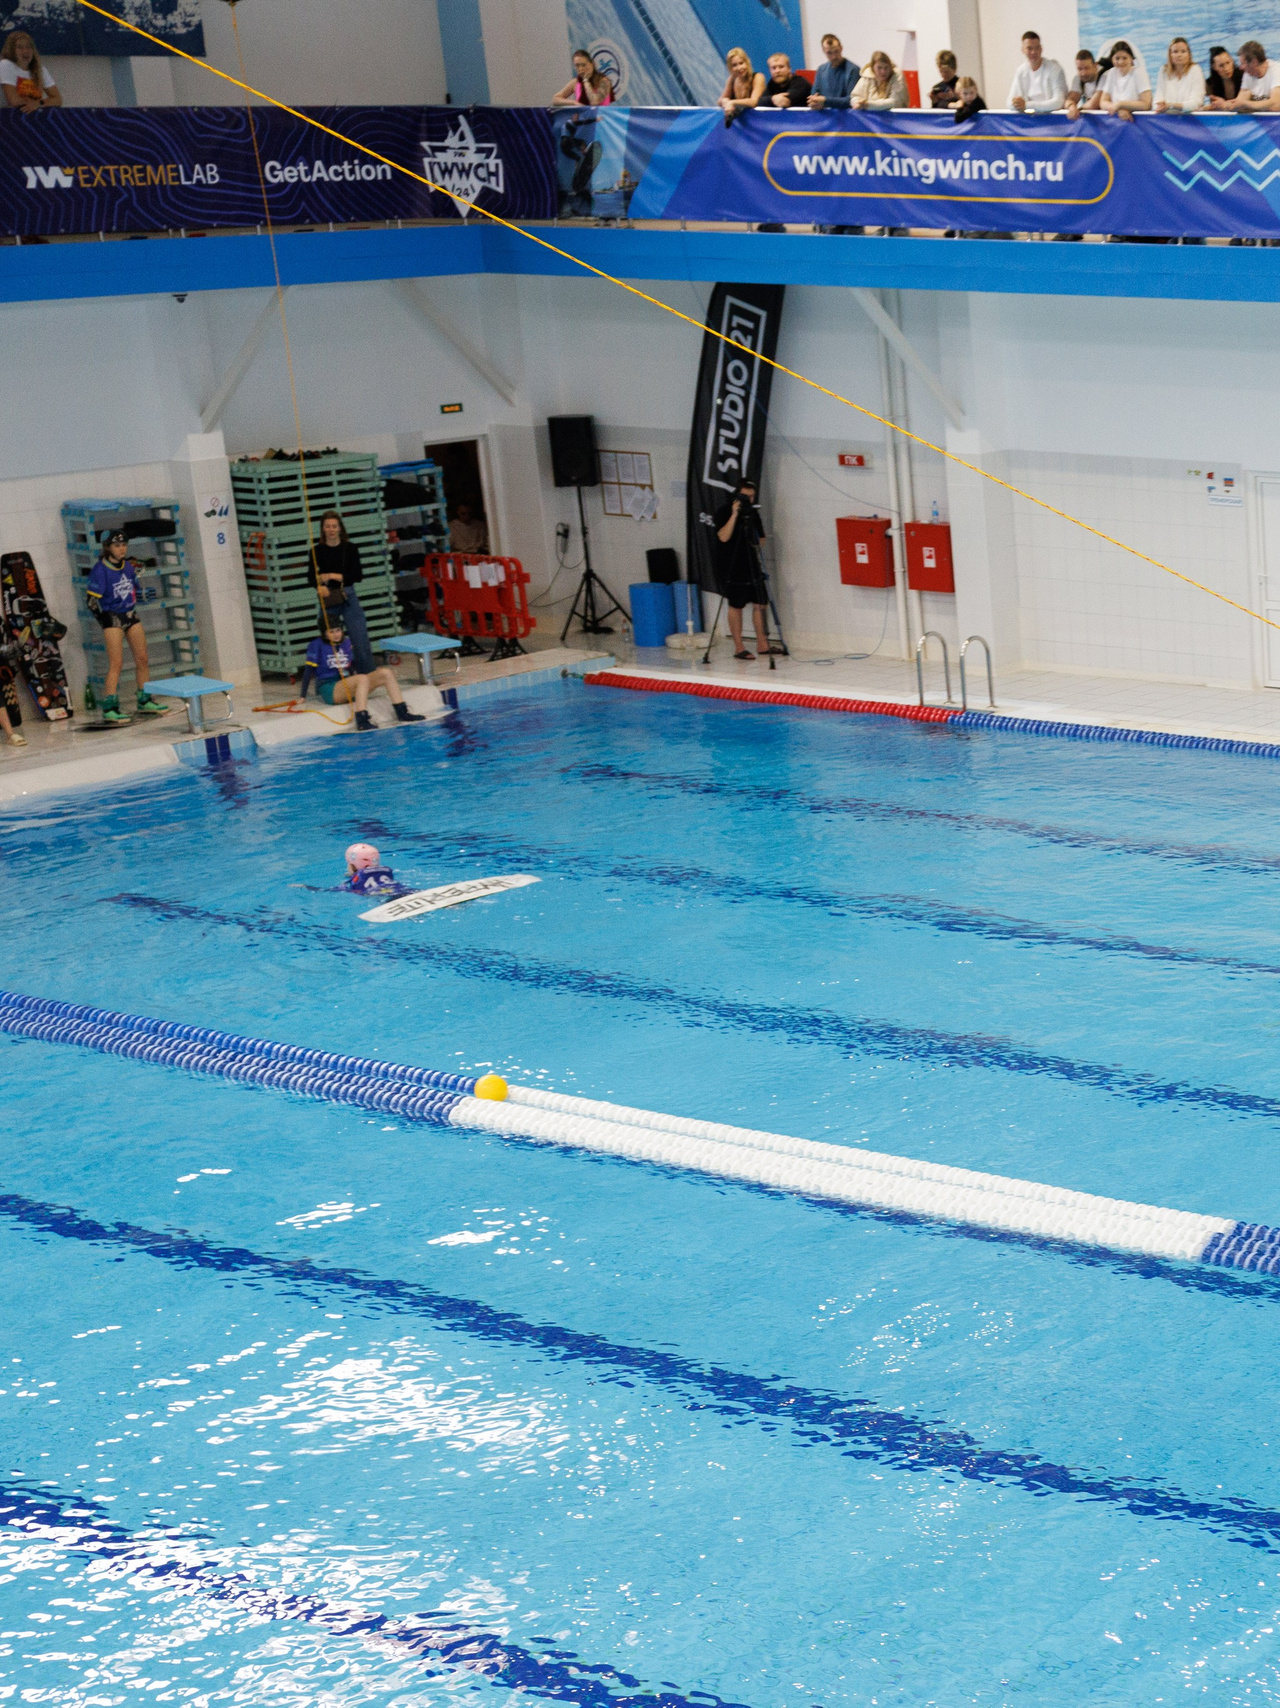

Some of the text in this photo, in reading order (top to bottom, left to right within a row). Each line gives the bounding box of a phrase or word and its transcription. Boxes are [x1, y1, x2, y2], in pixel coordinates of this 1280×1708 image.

[263, 159, 392, 184] GetAction
[792, 149, 1064, 185] www.kingwinch.ru
[716, 314, 755, 474] STUDIO 21
[216, 532, 226, 545] 8
